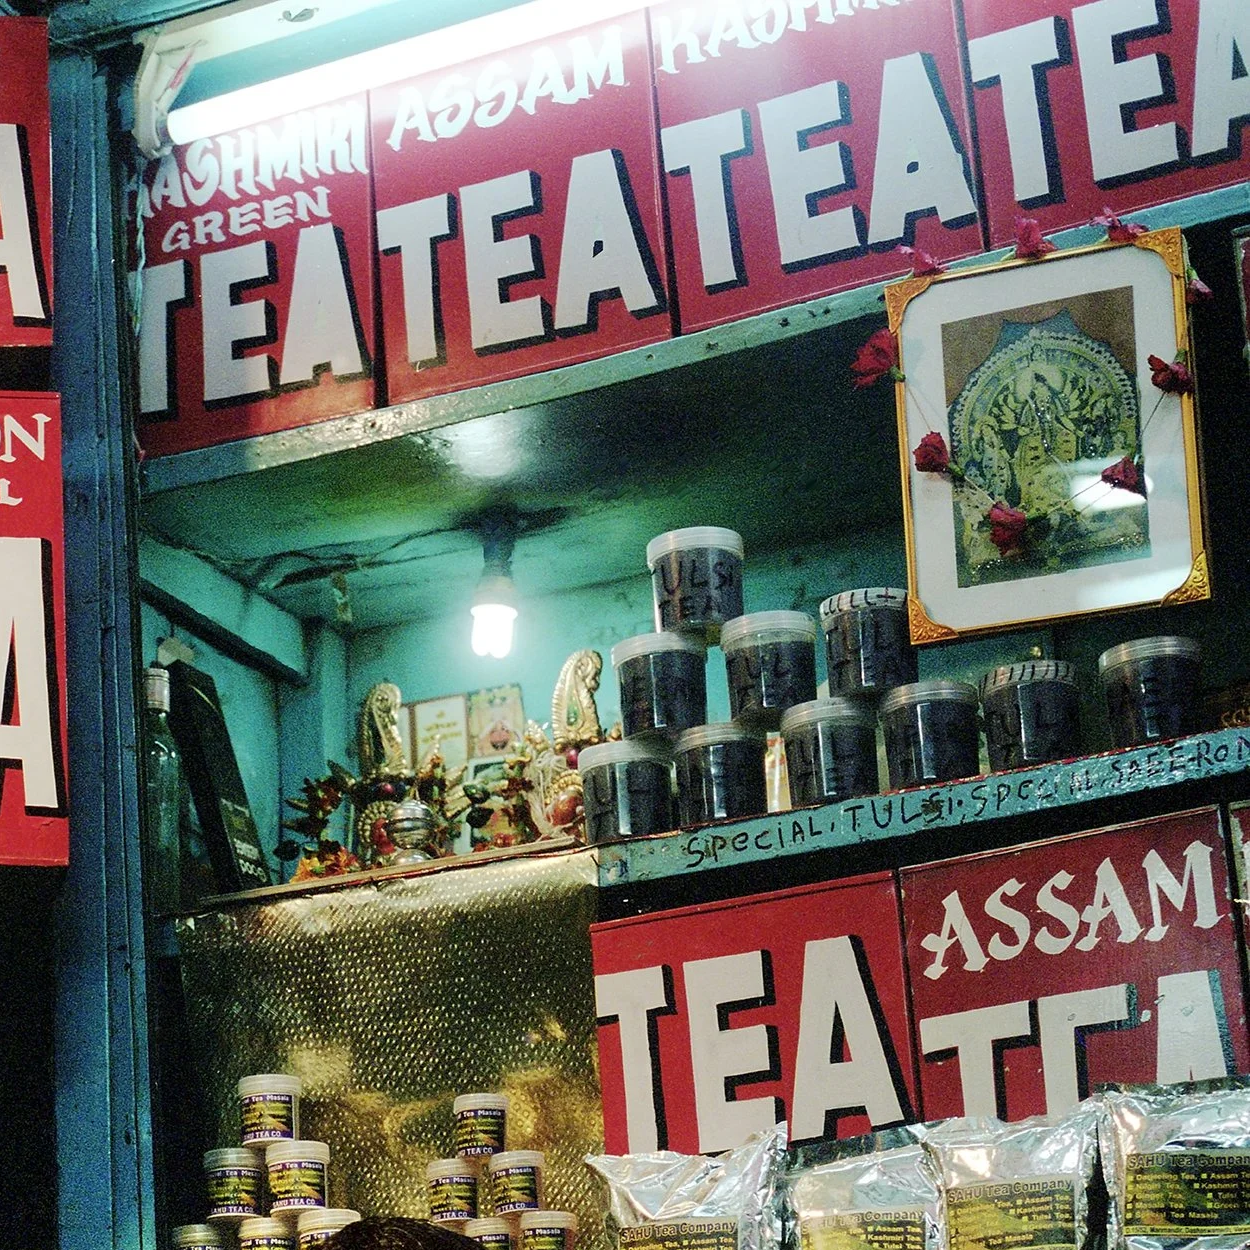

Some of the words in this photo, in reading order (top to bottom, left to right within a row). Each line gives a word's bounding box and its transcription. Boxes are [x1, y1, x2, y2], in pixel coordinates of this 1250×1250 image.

[385, 23, 631, 151] ASSAM
[161, 184, 332, 253] GREEN
[660, 51, 974, 288] TEA
[377, 148, 657, 365] TEA
[129, 222, 364, 414] TEA
[921, 838, 1227, 981] ASSAM
[594, 934, 909, 1155] TEA
[501, 1204, 514, 1212] TEA
[948, 1187, 982, 1204] SAHU
[986, 1185, 1009, 1196] Tea
[1013, 1179, 1072, 1194] Company
[1129, 1154, 1165, 1169] SAHU
[1169, 1154, 1194, 1166] Tea
[620, 1225, 652, 1243] SAHU
[652, 1224, 677, 1237] Tea
[679, 1221, 736, 1234] Company
[864, 1211, 924, 1223] Company
